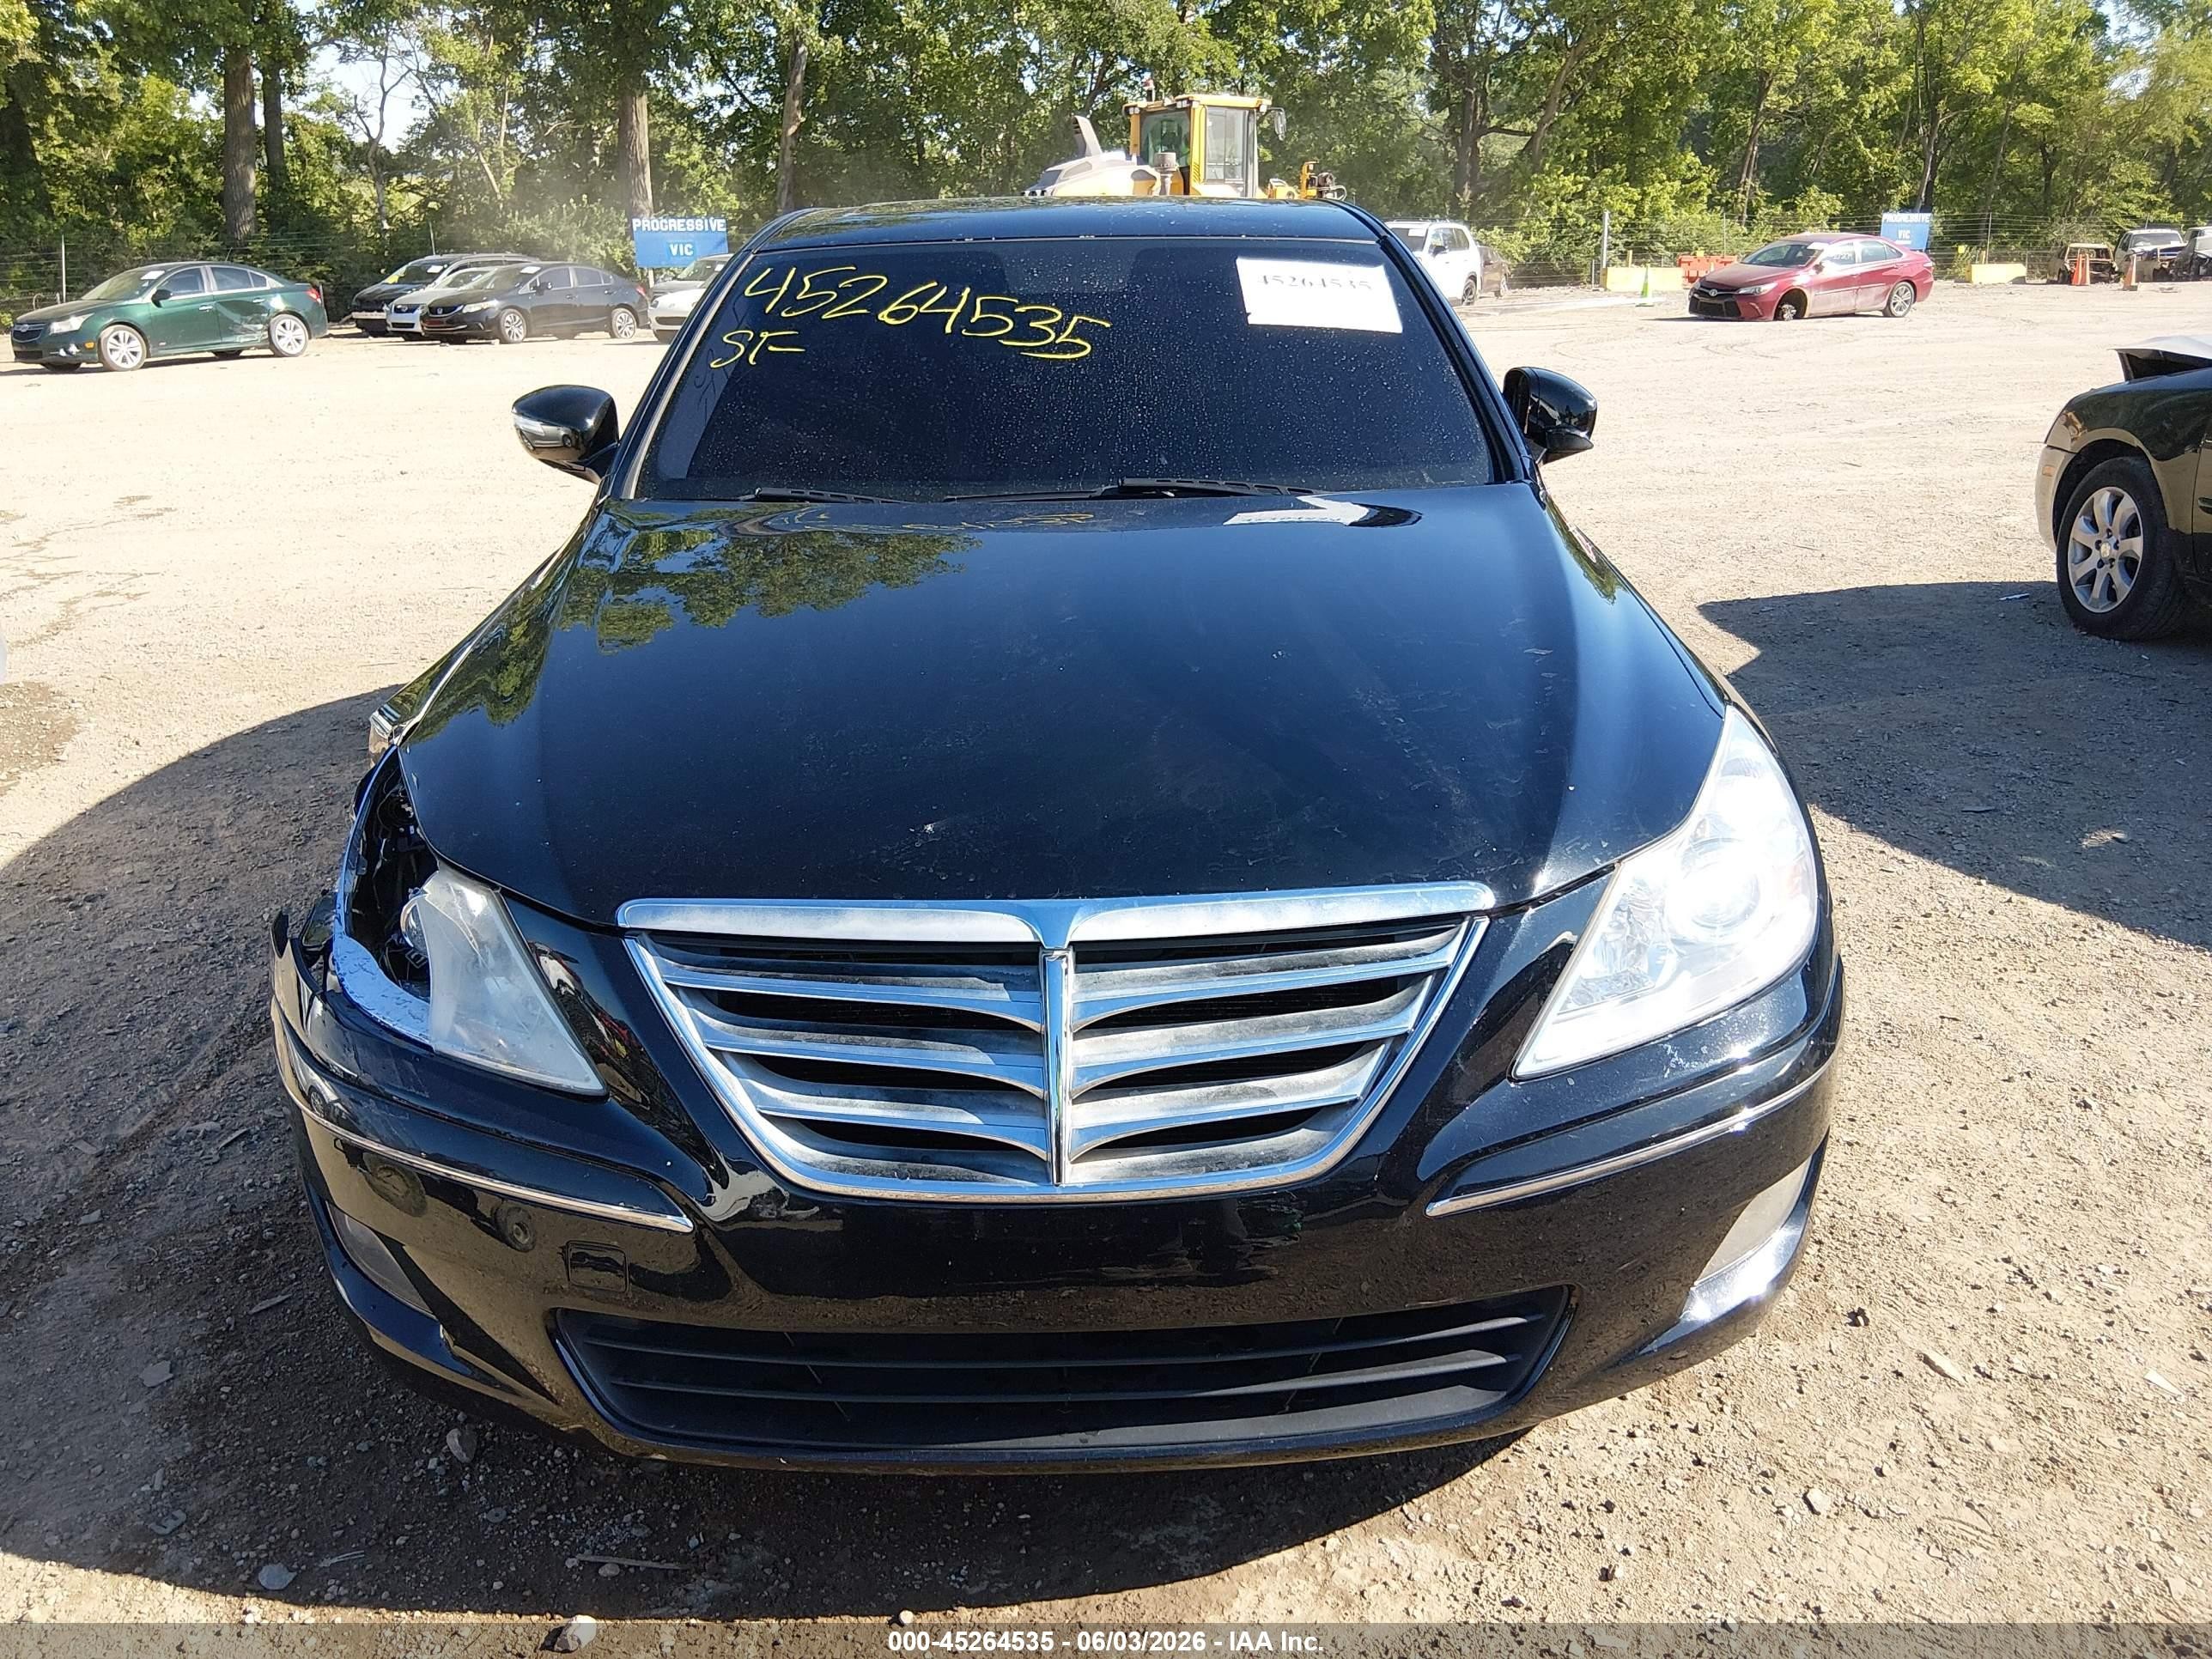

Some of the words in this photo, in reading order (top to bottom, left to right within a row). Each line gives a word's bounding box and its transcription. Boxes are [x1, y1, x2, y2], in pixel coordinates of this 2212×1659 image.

[632, 218, 726, 232] PROGRESSIVE
[669, 243, 694, 256] VIC
[744, 265, 1111, 359] 45264535
